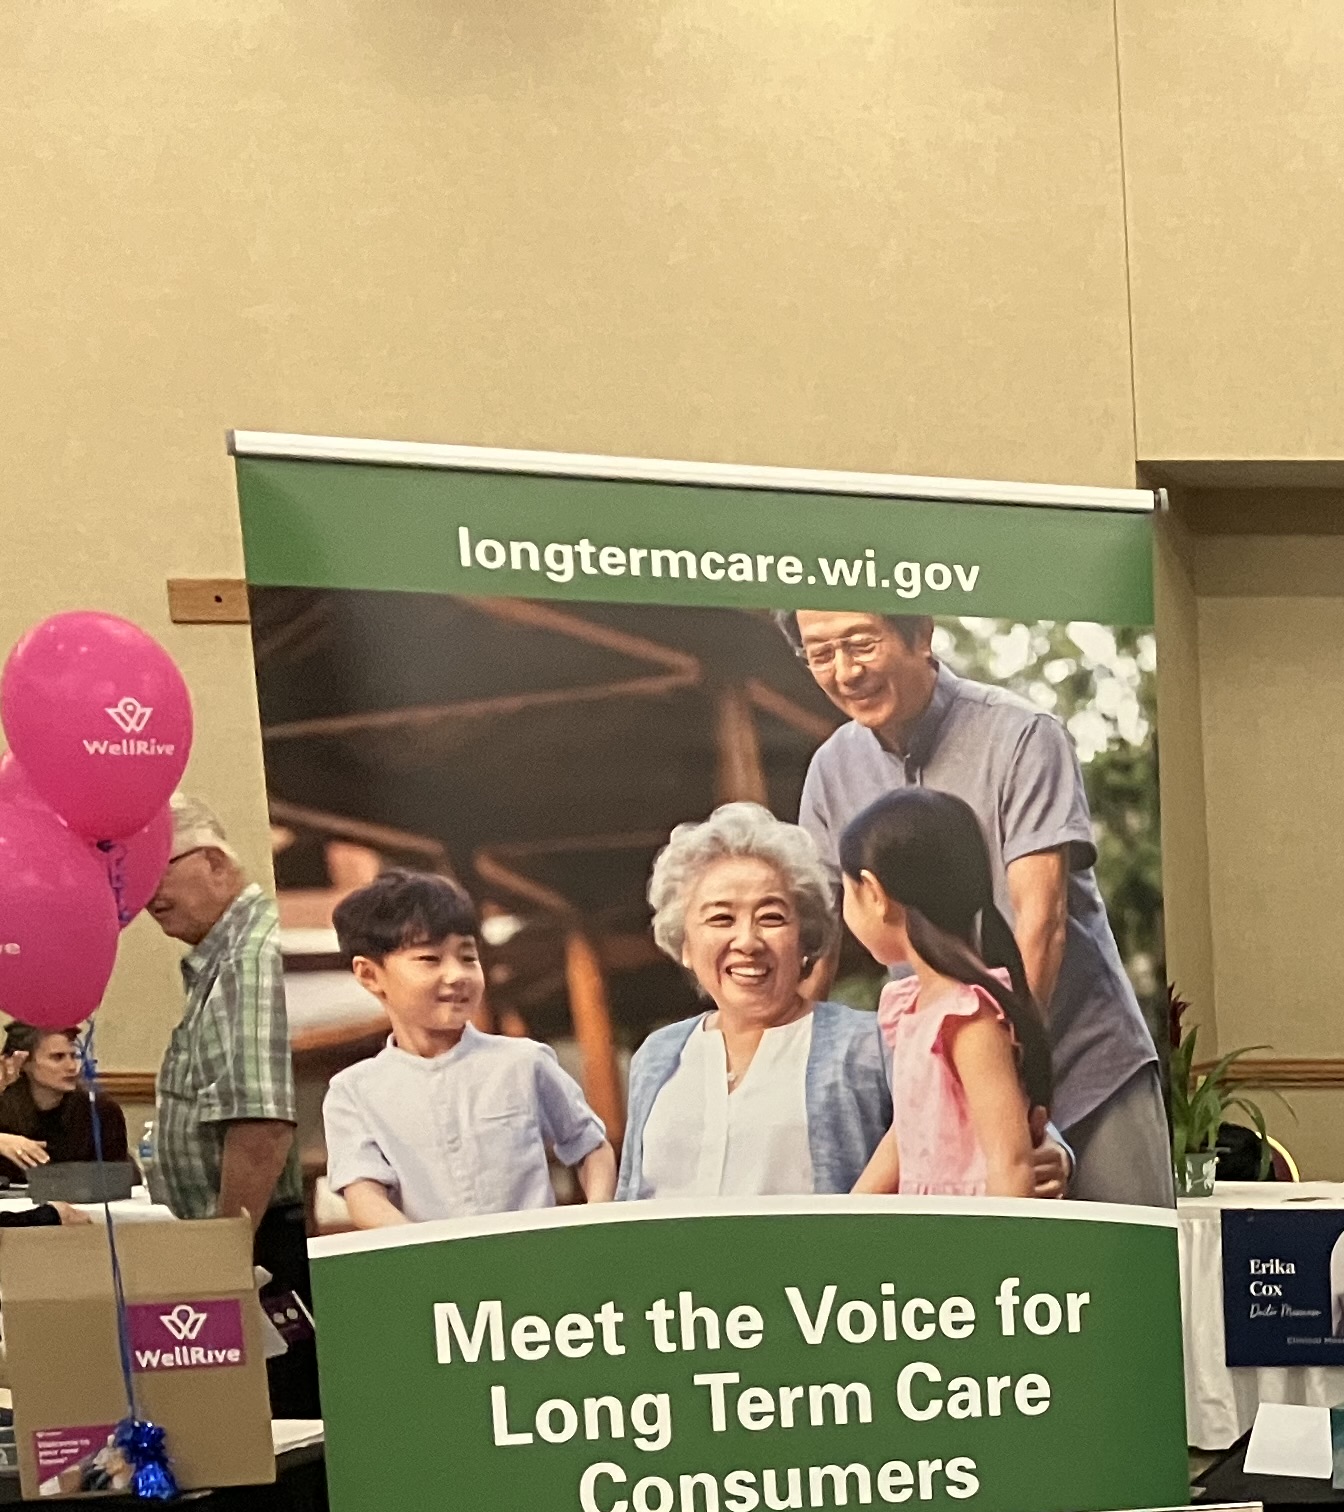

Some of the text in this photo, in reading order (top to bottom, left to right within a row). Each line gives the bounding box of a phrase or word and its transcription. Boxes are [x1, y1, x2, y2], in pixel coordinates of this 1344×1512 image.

[458, 526, 980, 597] longtermcare.wi.gov
[83, 739, 175, 756] WellRive
[1249, 1259, 1296, 1275] Erika
[1249, 1281, 1283, 1297] Cox
[432, 1277, 1091, 1364] Meet the Voice for
[136, 1346, 240, 1369] WellRive
[491, 1361, 1052, 1452] Long Term Care
